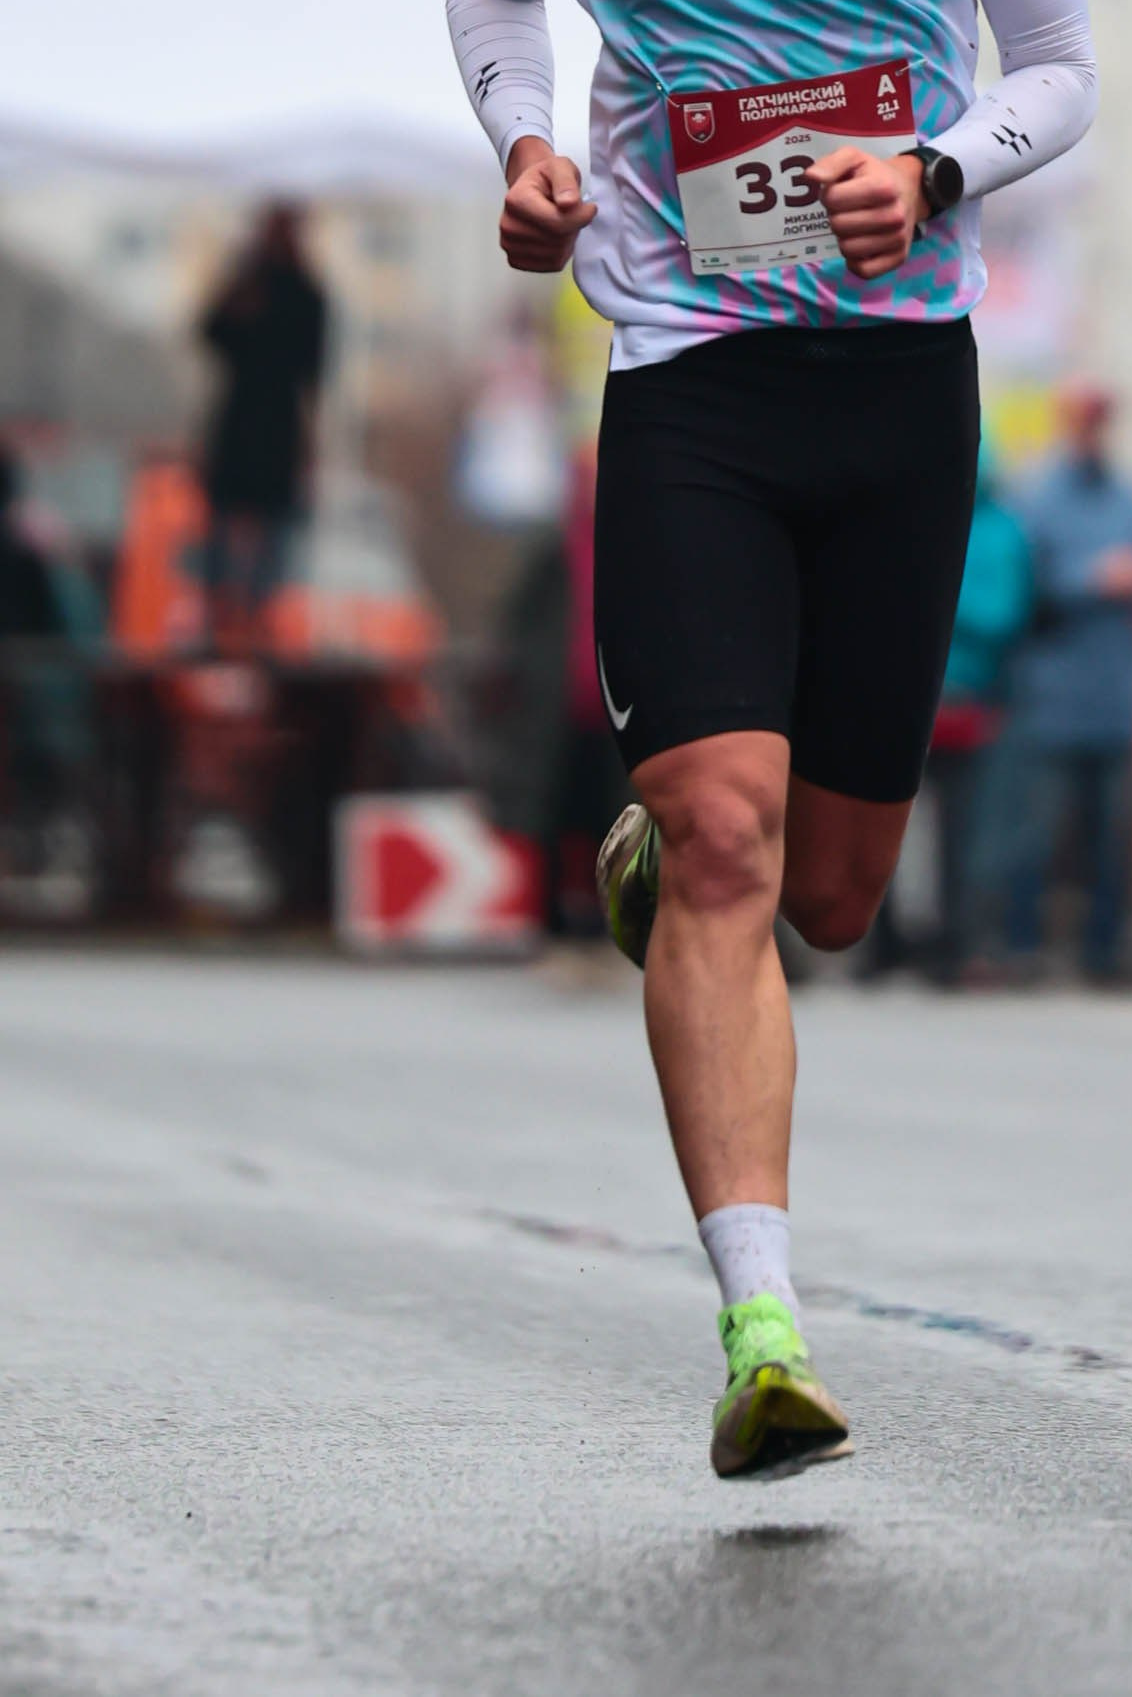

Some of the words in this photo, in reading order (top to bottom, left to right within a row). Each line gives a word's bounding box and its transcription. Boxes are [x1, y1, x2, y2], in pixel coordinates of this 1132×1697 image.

[738, 82, 845, 111] ГАТЧИНСКИЙ
[740, 98, 847, 122] ПОЛУМАРАФОН
[877, 99, 900, 115] 21.1
[784, 134, 812, 145] 2025
[735, 155, 820, 214] 33
[784, 211, 828, 225] МИХАИ
[783, 220, 830, 236] ЛОГИНО
